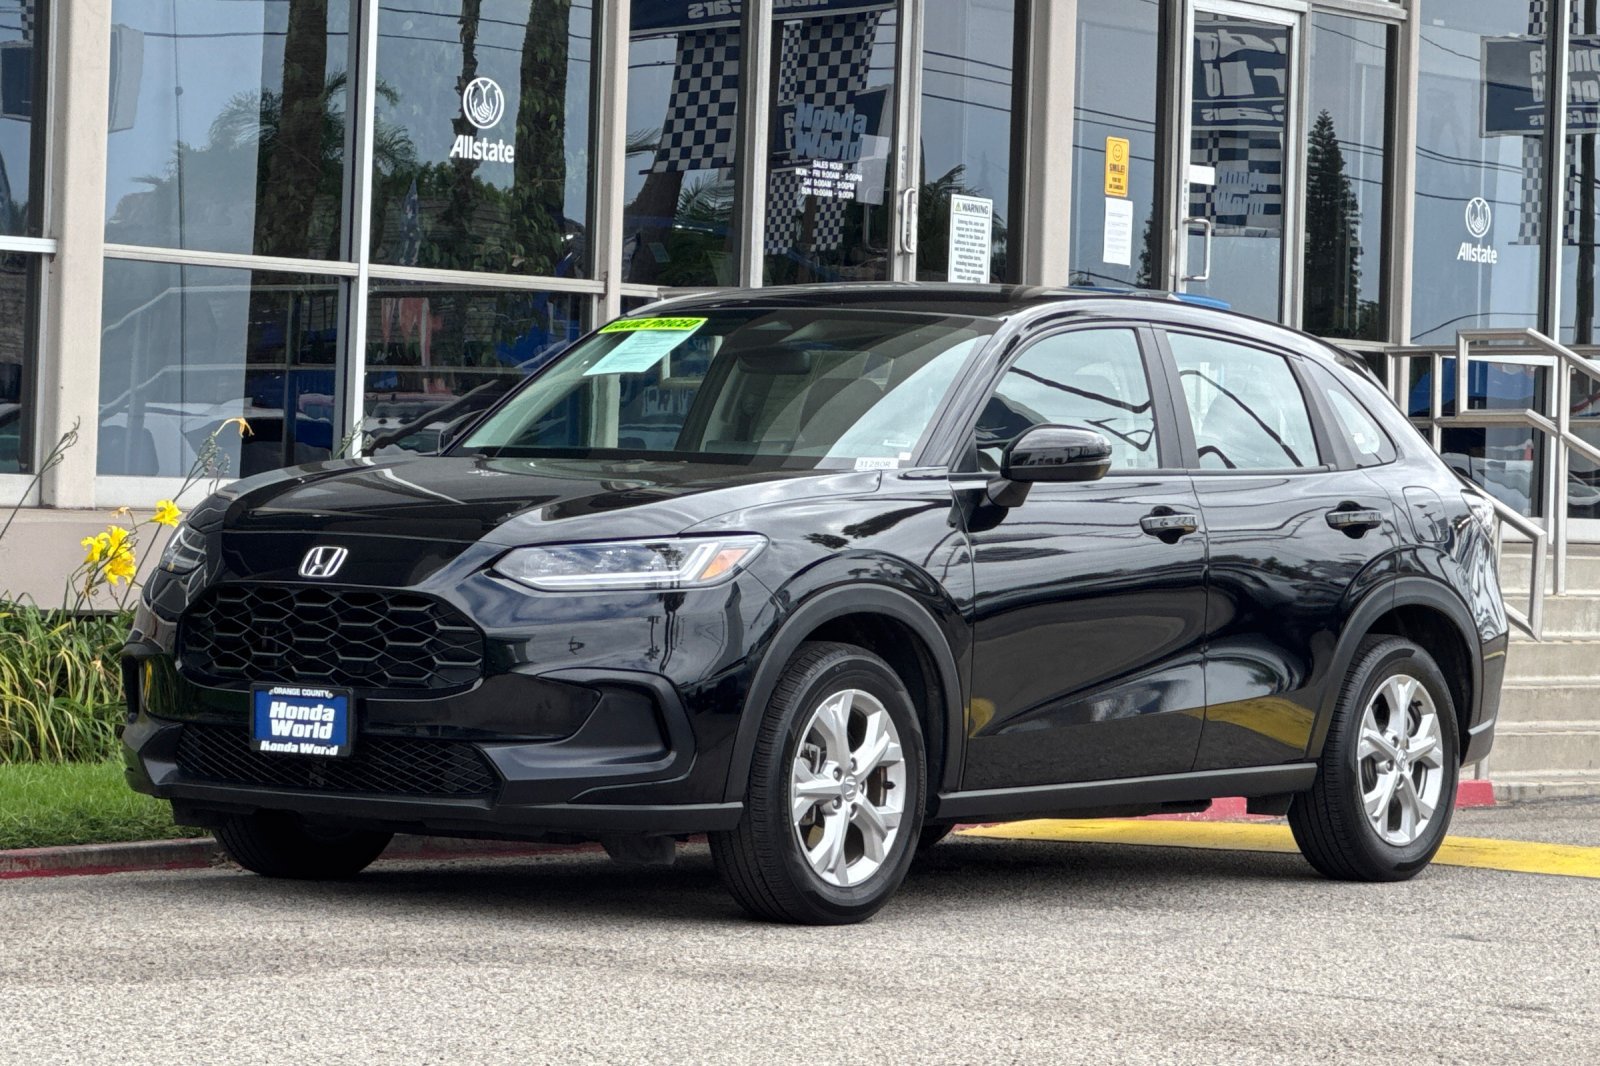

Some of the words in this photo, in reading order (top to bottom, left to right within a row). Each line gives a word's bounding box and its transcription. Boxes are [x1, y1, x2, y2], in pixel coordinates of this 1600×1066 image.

[449, 134, 515, 163] Allstate
[795, 167, 807, 176] MON
[812, 160, 828, 169] SALES
[829, 161, 843, 171] HOUR
[962, 203, 988, 215] WARNING
[1457, 242, 1498, 264] Allstate
[274, 687, 300, 696] ORANGE
[301, 688, 329, 697] COUNTY
[269, 701, 335, 722] Honda
[271, 719, 334, 740] World
[260, 740, 298, 753] Honda
